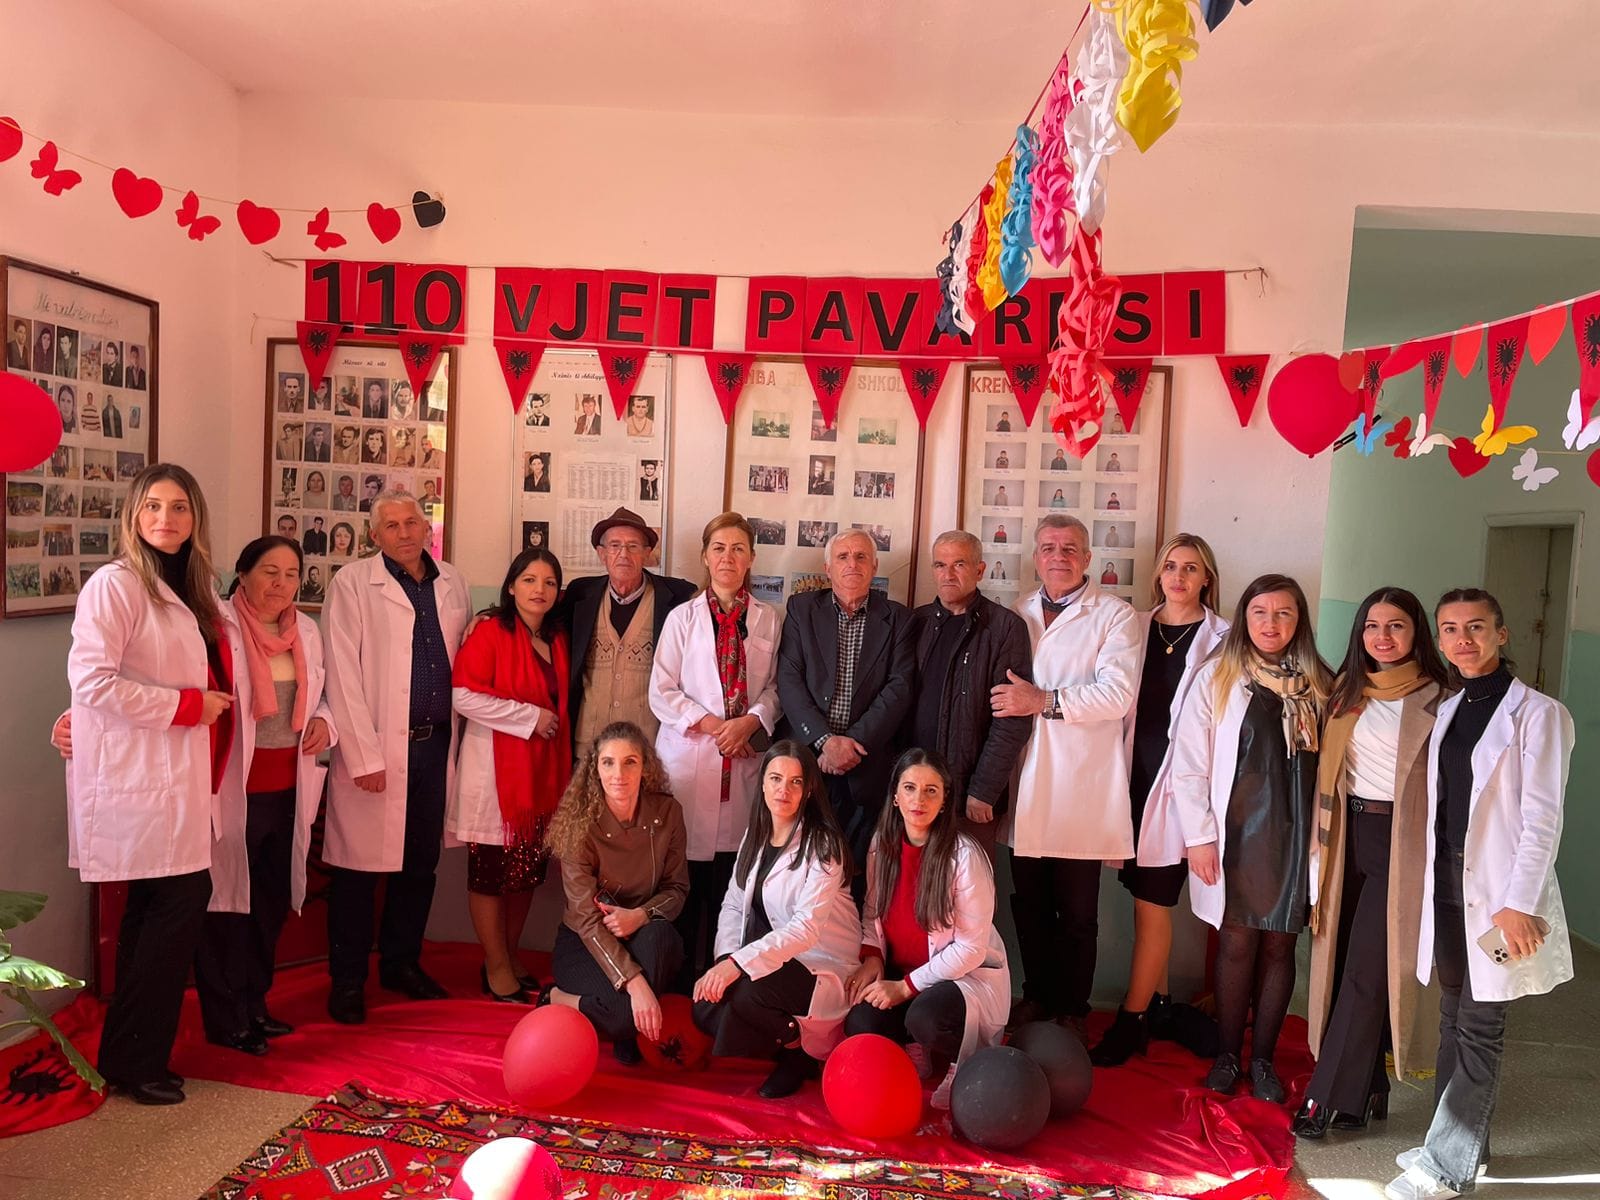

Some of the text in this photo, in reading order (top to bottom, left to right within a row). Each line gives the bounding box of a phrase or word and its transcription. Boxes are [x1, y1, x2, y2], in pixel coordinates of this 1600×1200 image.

[312, 261, 1202, 351] 110 VJET PAVRSI
